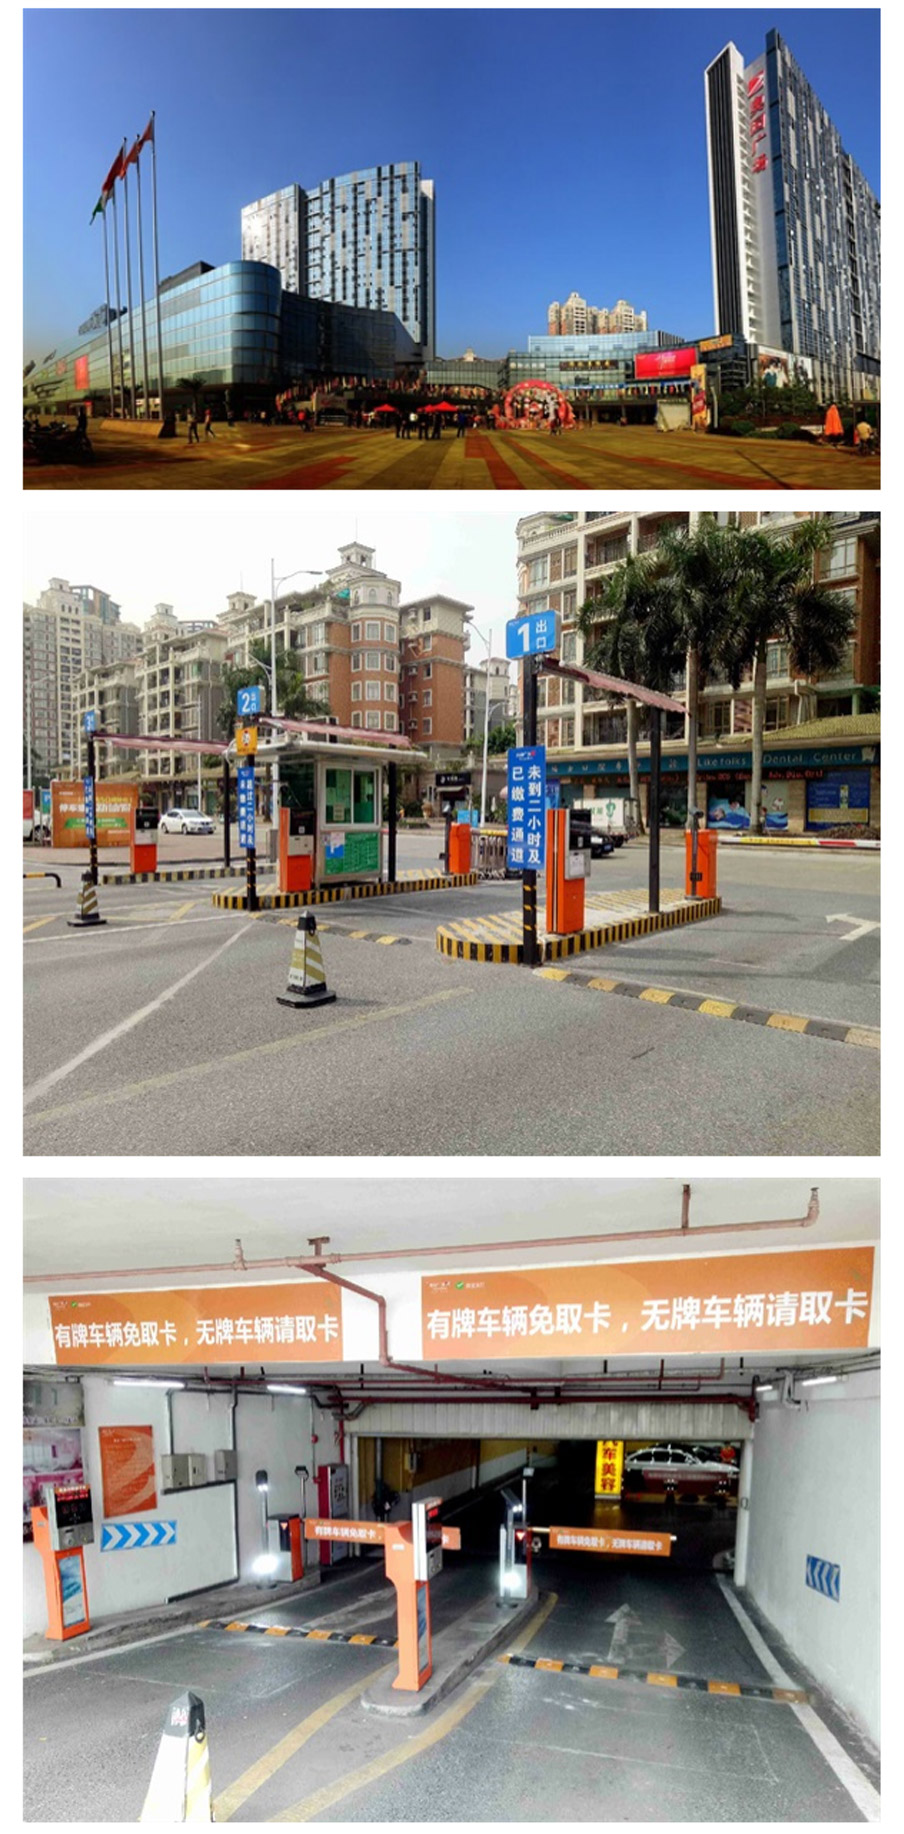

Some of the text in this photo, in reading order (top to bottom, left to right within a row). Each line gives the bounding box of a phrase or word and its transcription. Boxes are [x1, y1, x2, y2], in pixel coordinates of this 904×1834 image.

[517, 622, 530, 652] 1
[536, 619, 547, 649] 出口
[241, 692, 251, 713] 2
[763, 752, 803, 764] Dental
[813, 749, 857, 762] Center
[511, 766, 525, 863] 已缴费通道
[527, 764, 542, 864] 未到二小时及
